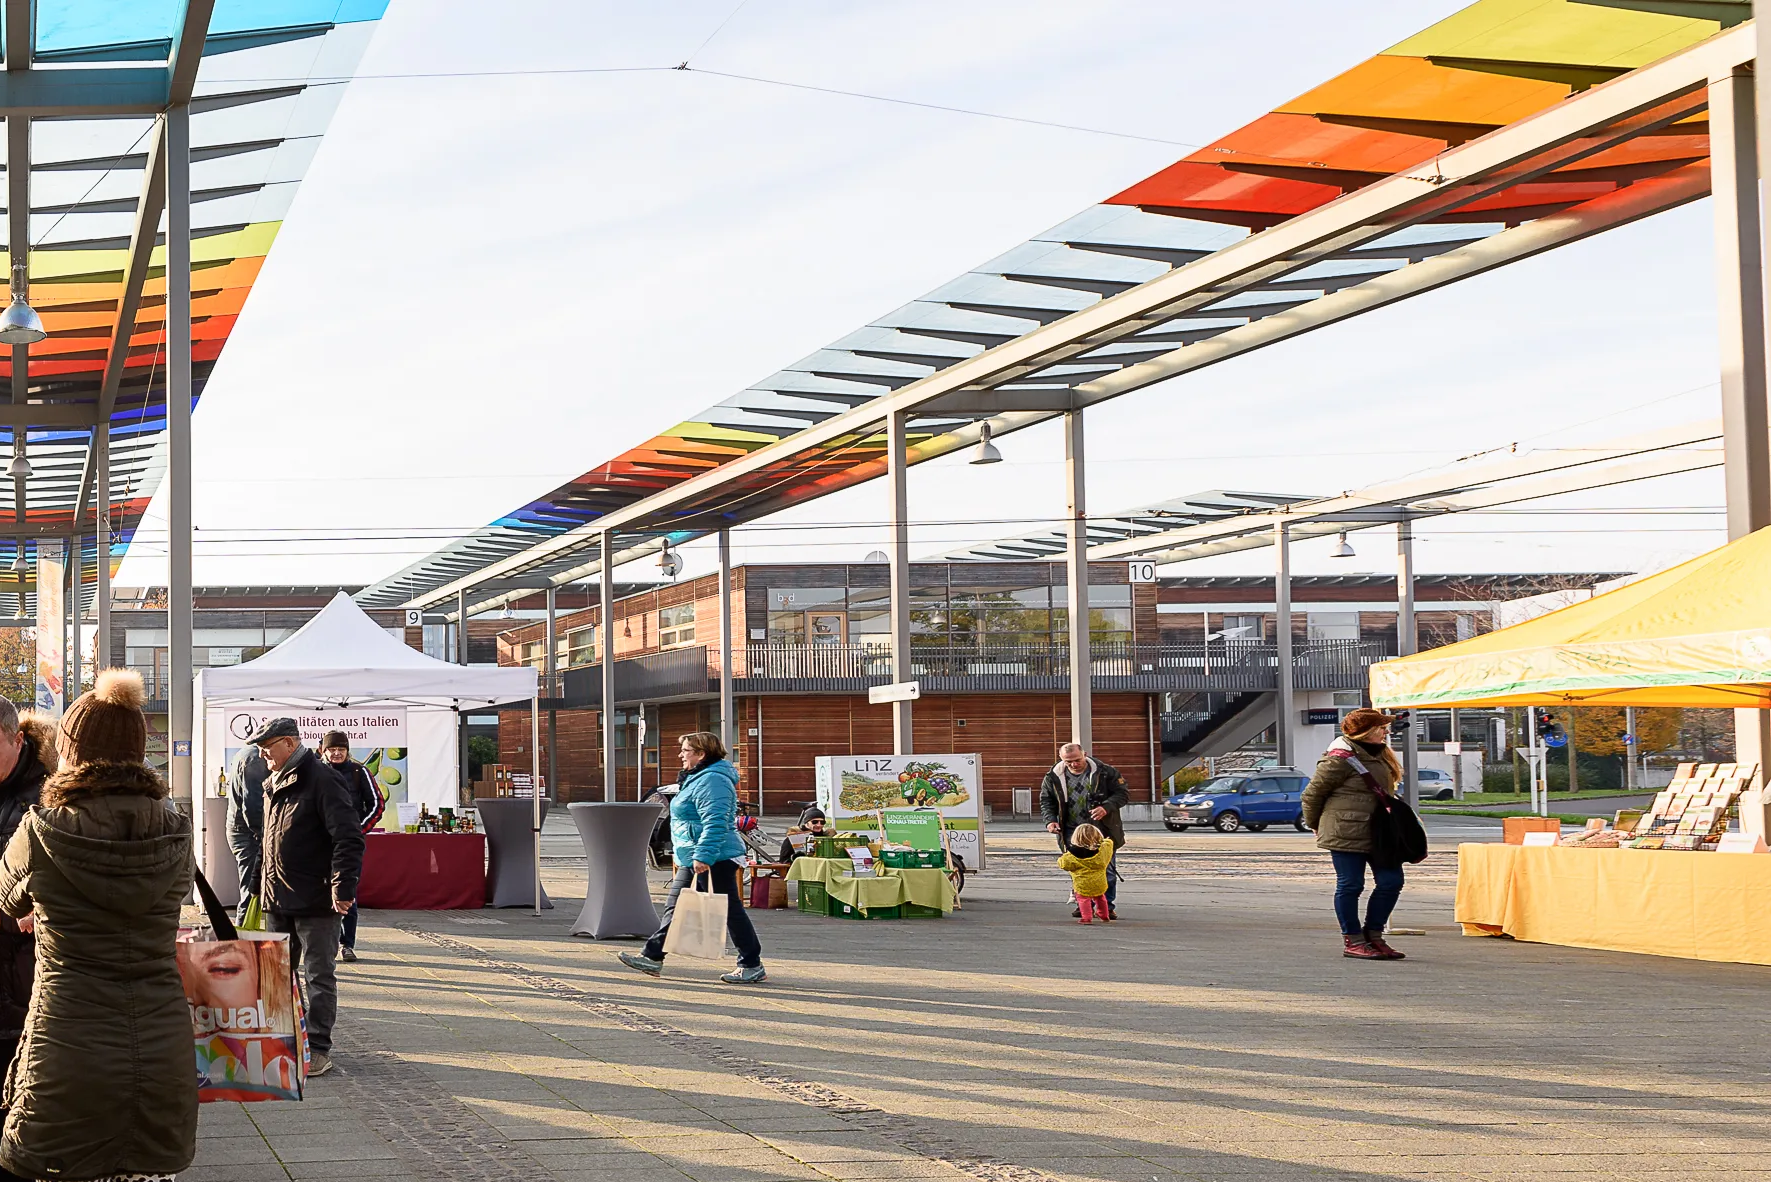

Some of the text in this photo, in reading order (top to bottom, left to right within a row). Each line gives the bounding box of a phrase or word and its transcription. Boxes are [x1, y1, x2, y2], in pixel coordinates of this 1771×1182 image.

[1130, 563, 1154, 581] 10
[409, 610, 419, 625] 9
[339, 718, 359, 727] aus
[362, 716, 399, 727] Italien
